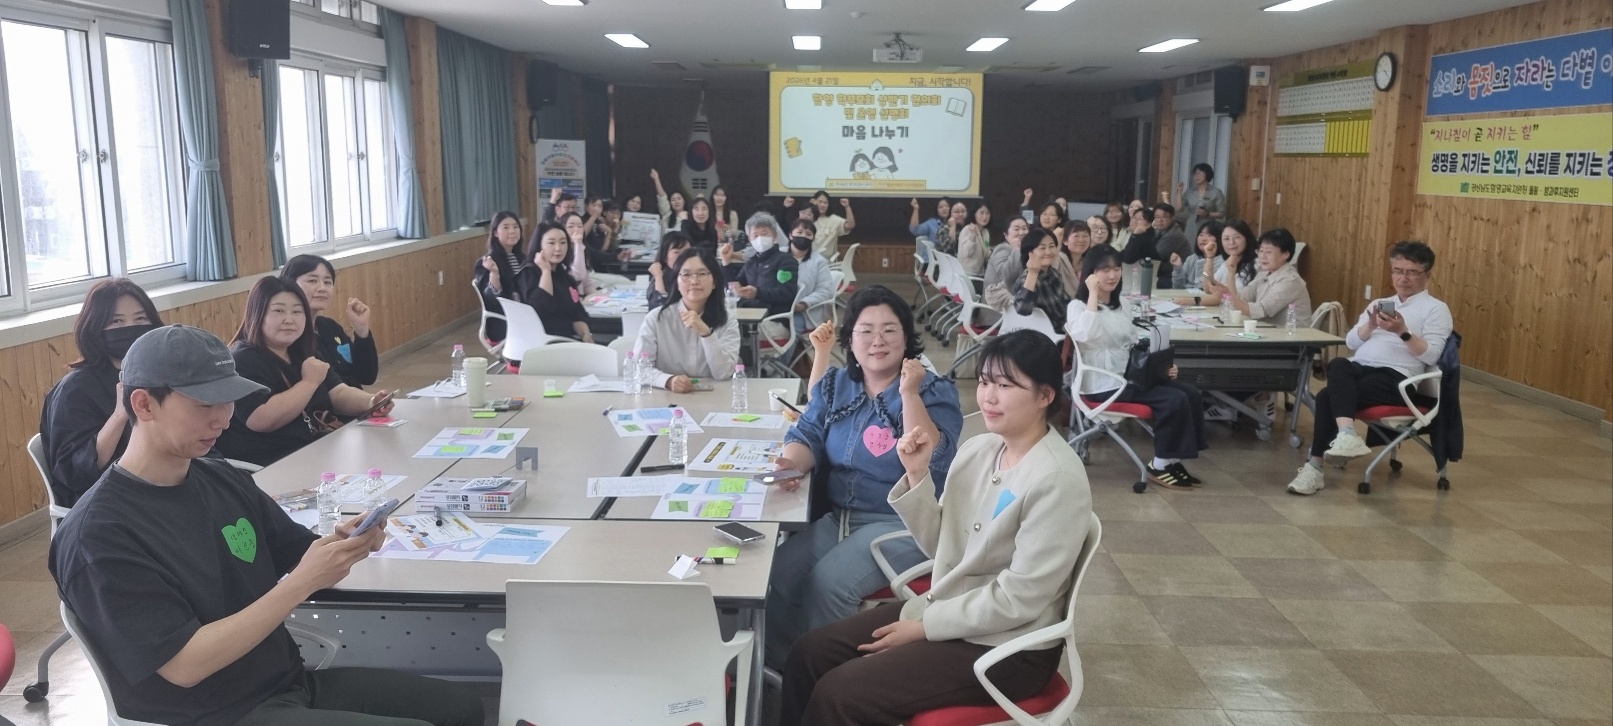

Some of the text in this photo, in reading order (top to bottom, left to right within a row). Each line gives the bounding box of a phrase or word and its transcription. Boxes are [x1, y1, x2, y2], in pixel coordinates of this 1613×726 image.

[1432, 69, 1466, 97] 소리와
[1468, 62, 1511, 99] 몸짓으로
[1514, 56, 1555, 90] 자라는
[1560, 48, 1597, 89] 다볕
[930, 77, 972, 88] 시작합니다!
[842, 124, 909, 141] 마음 나누기
[1474, 127, 1483, 142] 곧
[1487, 126, 1517, 142] 지키는
[1431, 153, 1459, 173] 생명을
[1460, 152, 1491, 174] 지키는
[1493, 149, 1521, 177] 안전,
[1525, 152, 1561, 175] 신뢰를
[1564, 152, 1603, 177] 지키는
